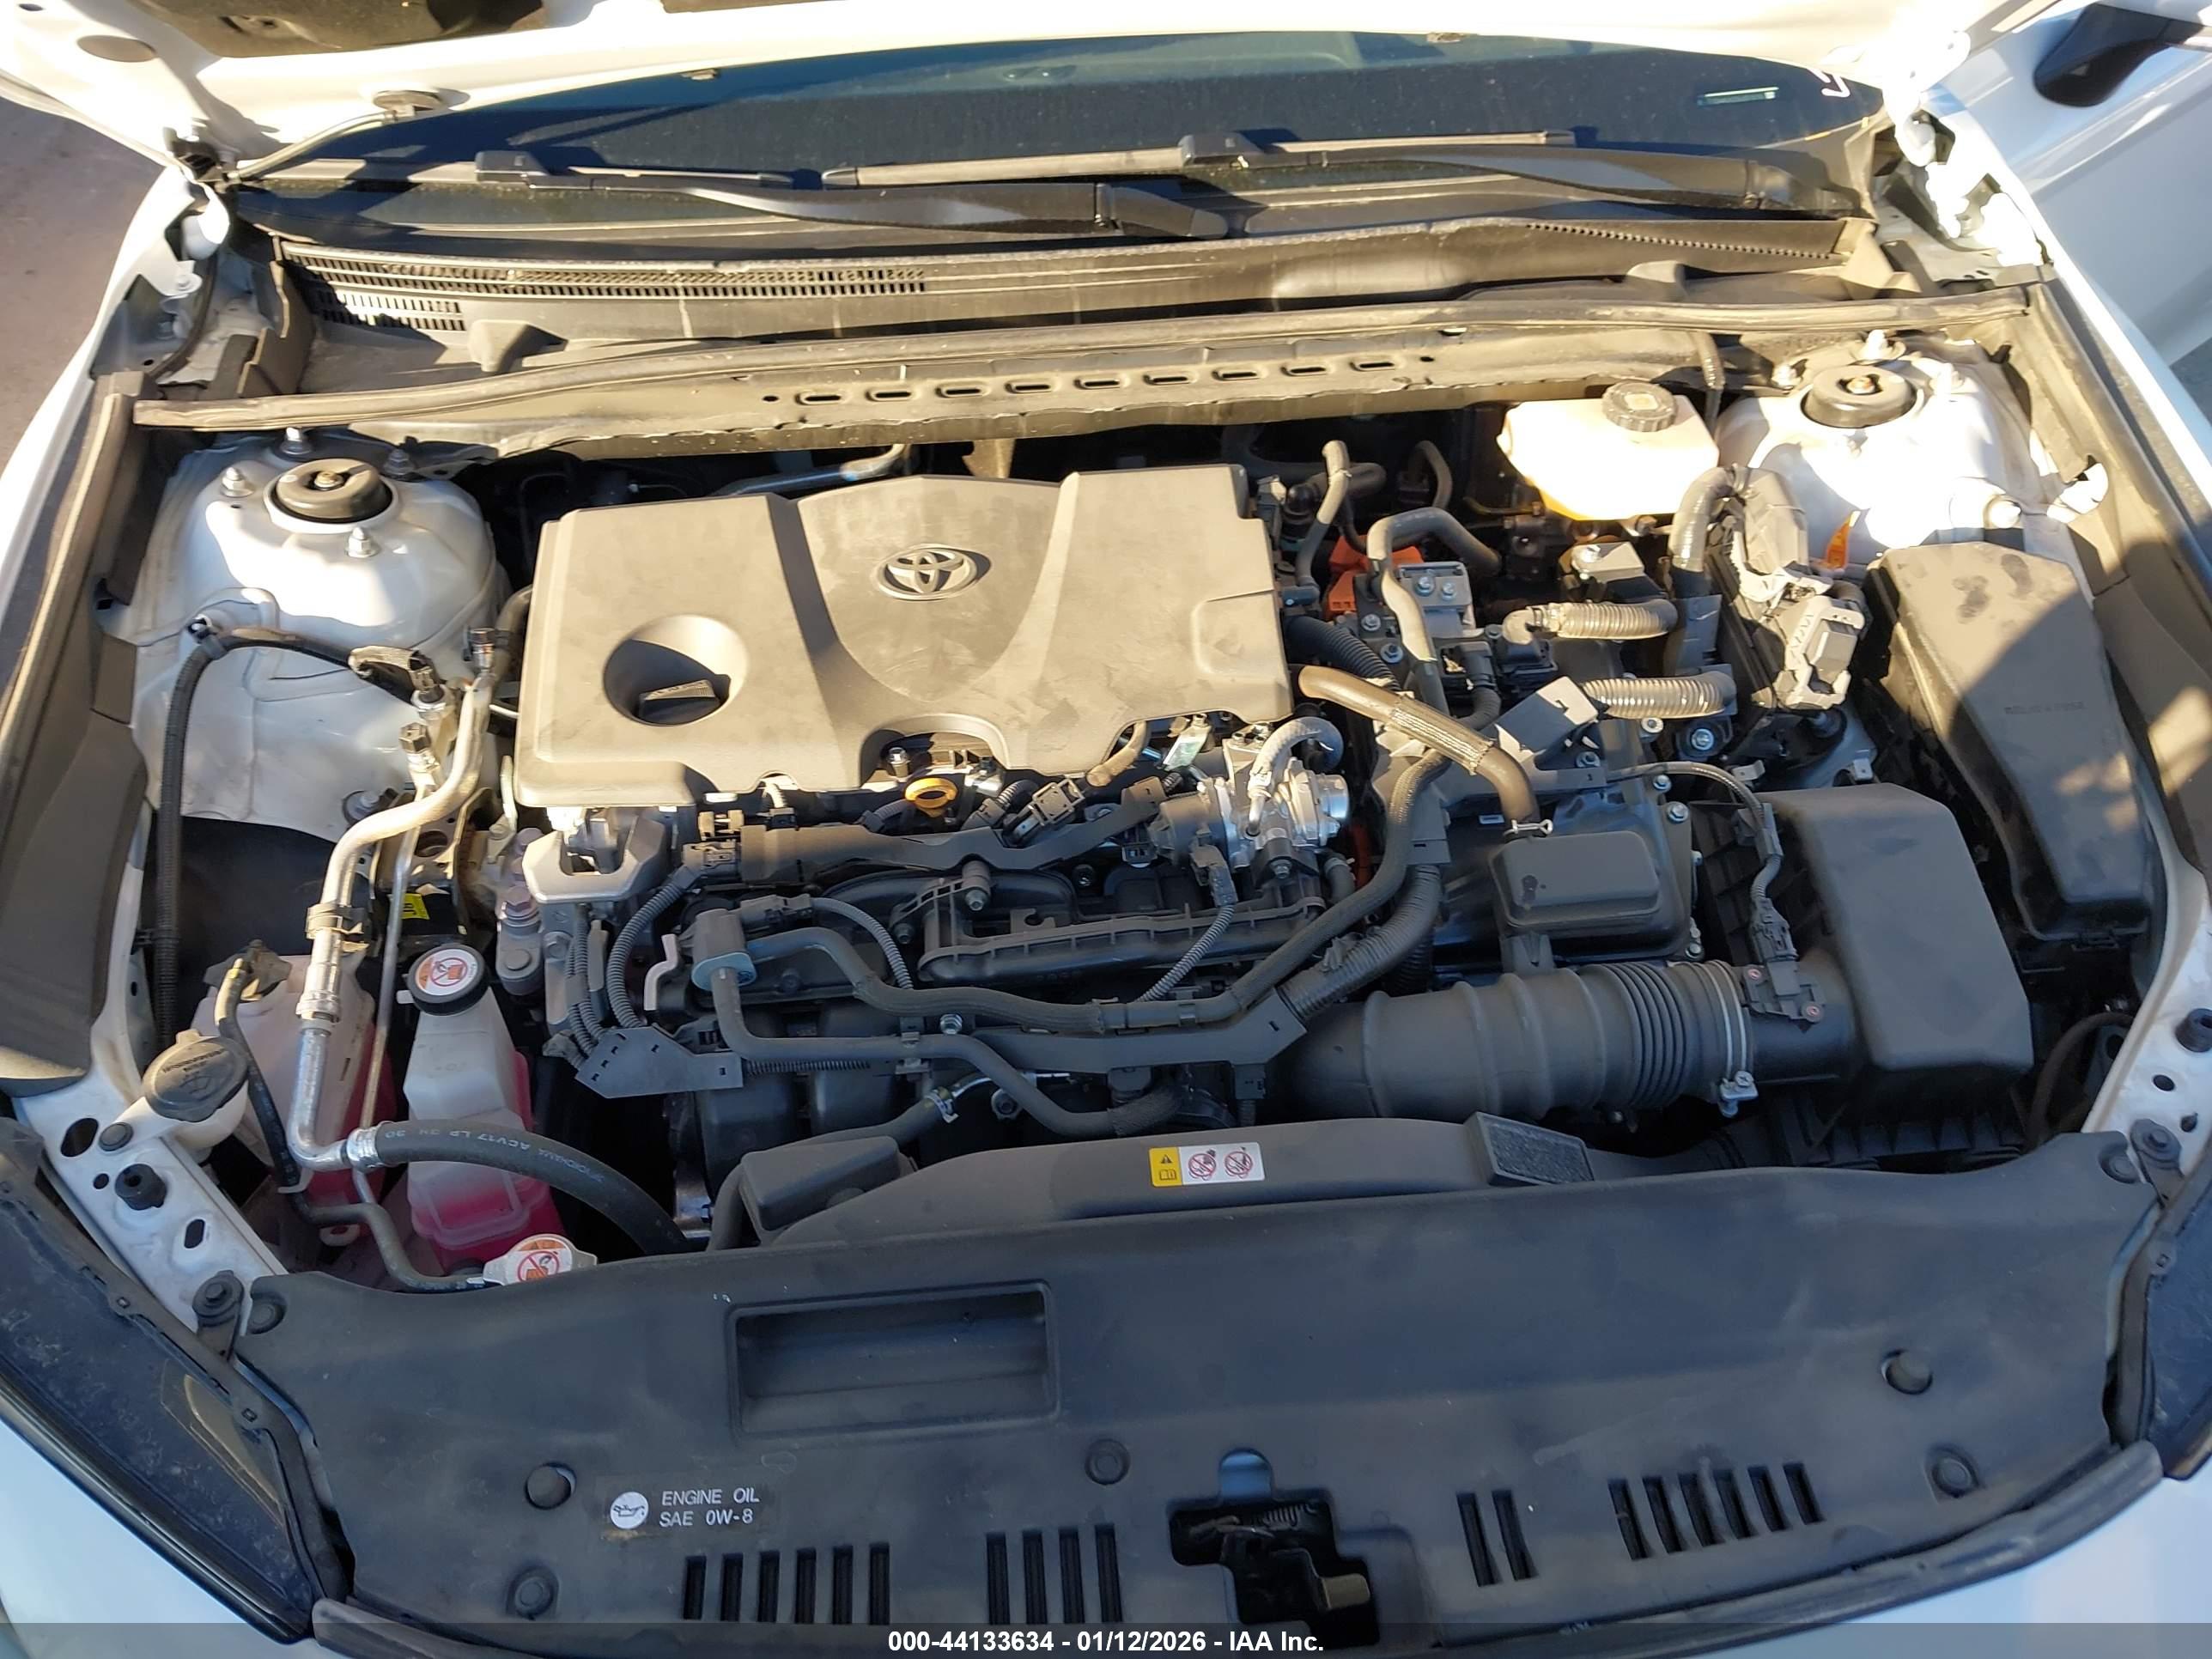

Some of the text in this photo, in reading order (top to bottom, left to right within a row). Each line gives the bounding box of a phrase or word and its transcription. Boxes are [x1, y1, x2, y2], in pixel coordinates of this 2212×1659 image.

[661, 1487, 760, 1506] ENGINE OIL
[659, 1509, 753, 1528] SAE 0W-8
